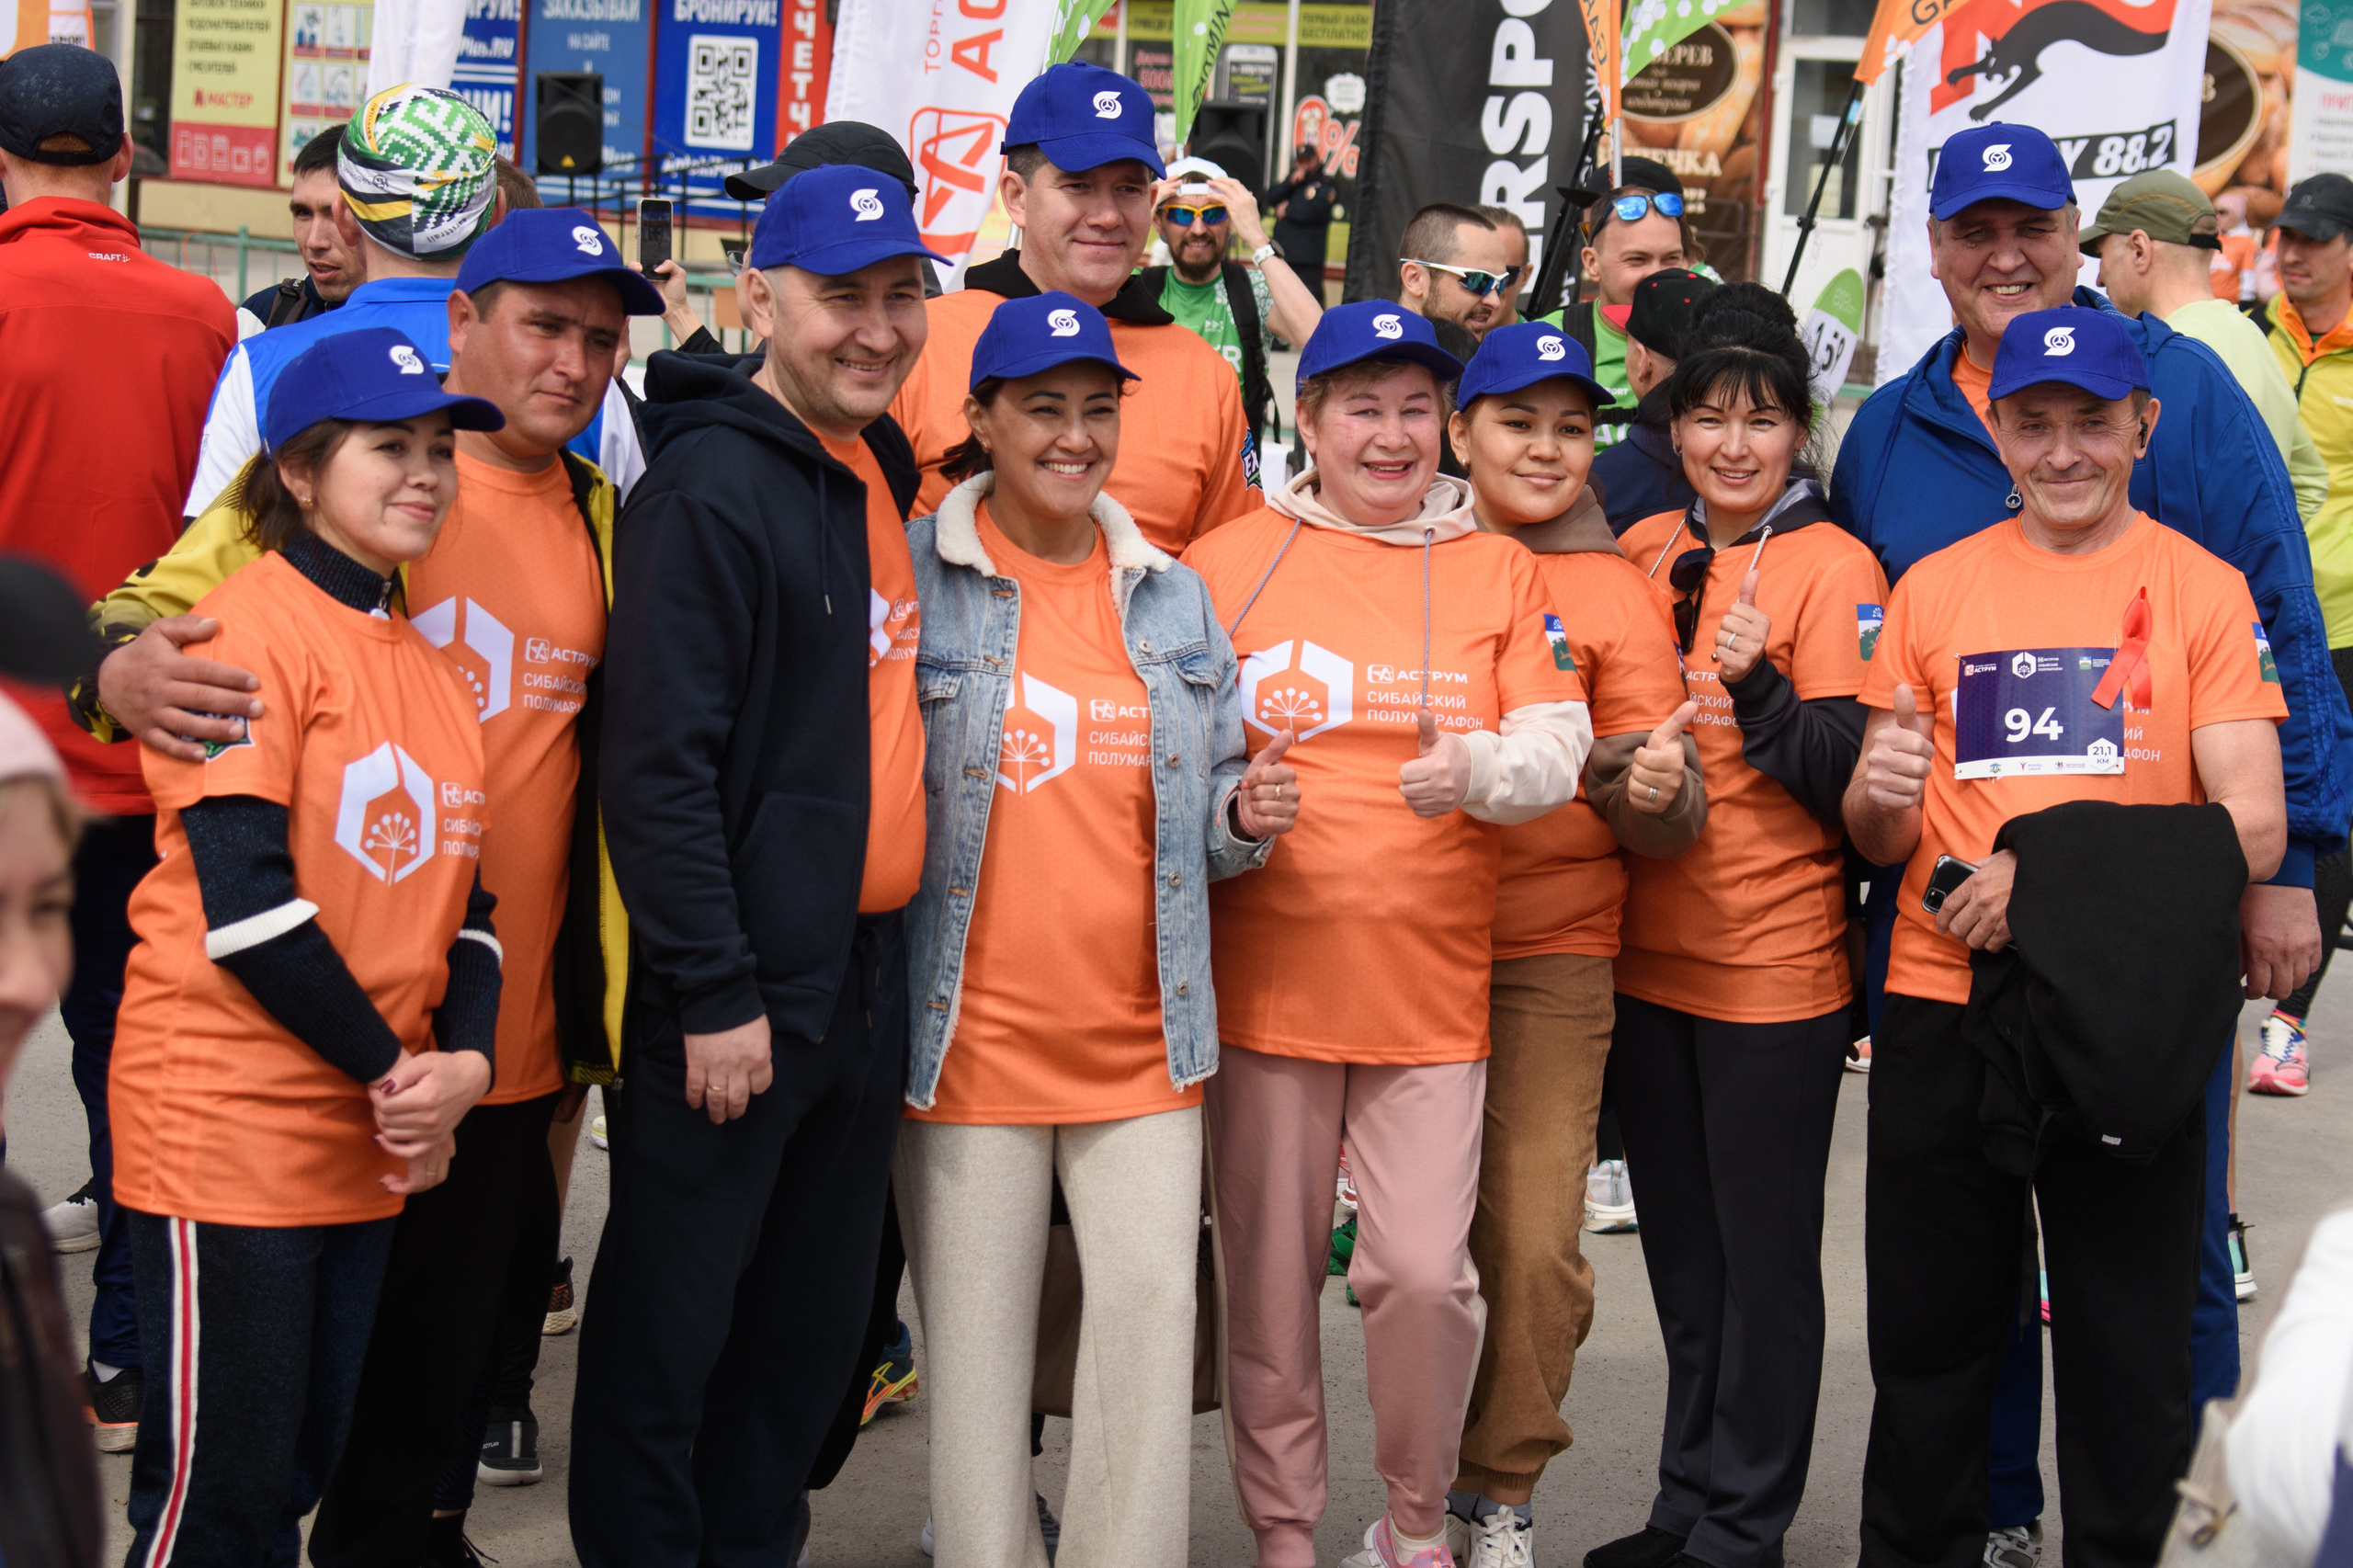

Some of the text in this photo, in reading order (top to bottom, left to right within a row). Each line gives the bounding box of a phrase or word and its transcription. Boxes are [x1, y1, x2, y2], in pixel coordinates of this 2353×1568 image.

[784, 0, 816, 145] ЧЕТЧ
[89, 253, 121, 262] CRAFT
[1686, 671, 1721, 683] АСТР
[1367, 690, 1467, 710] СИБАЙСКИЙ
[1367, 709, 1483, 730] ПОЛУМРАФОН
[2005, 707, 2064, 743] 94
[2092, 745, 2112, 756] 21,1
